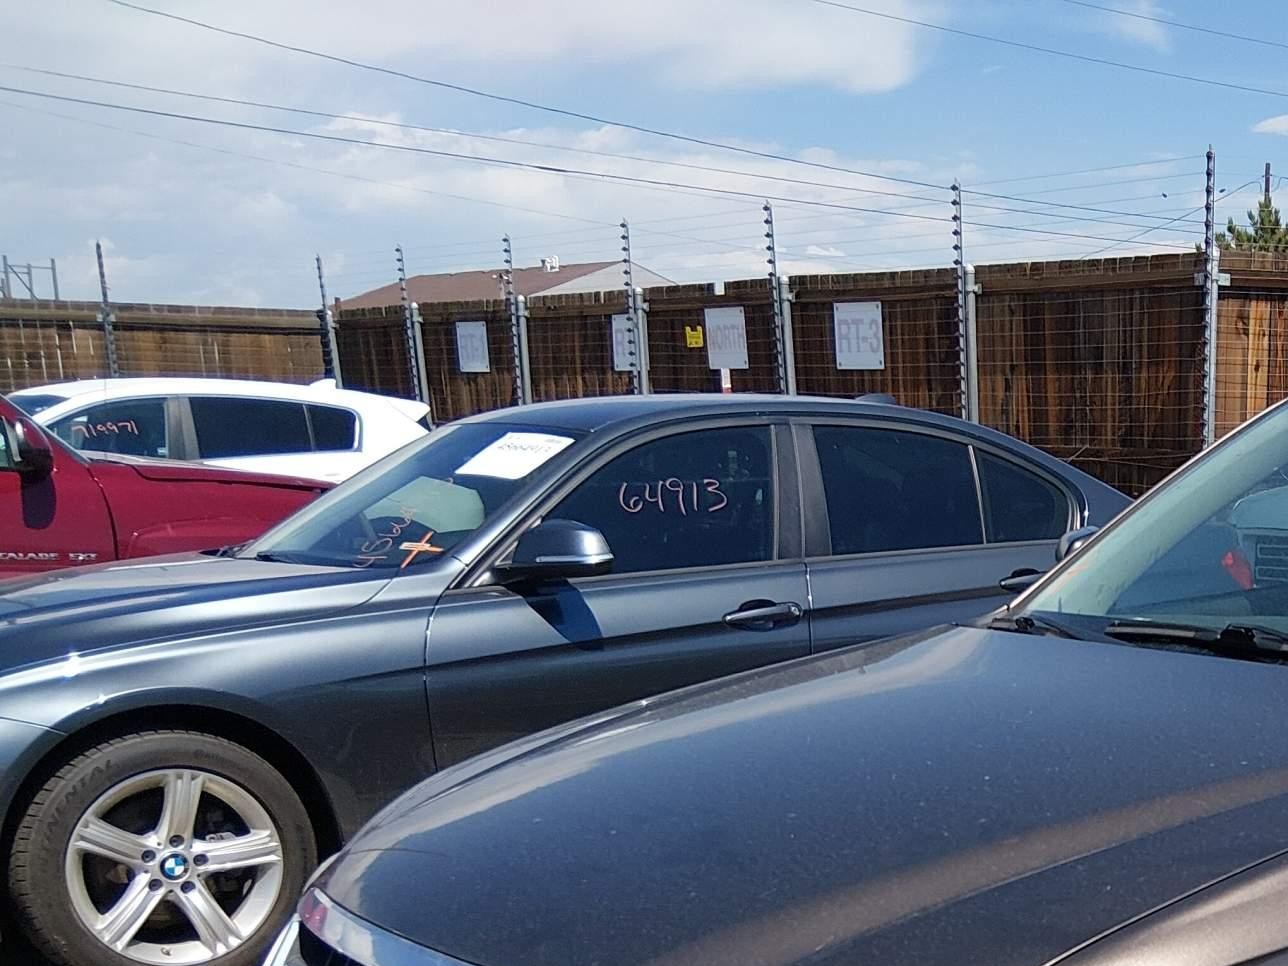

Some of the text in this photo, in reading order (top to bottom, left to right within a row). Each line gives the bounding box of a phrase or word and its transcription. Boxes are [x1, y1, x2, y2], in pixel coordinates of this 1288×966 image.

[709, 321, 746, 351] NORTH
[838, 318, 881, 353] RT-3
[71, 420, 139, 439] 719971
[619, 477, 728, 516] 64913
